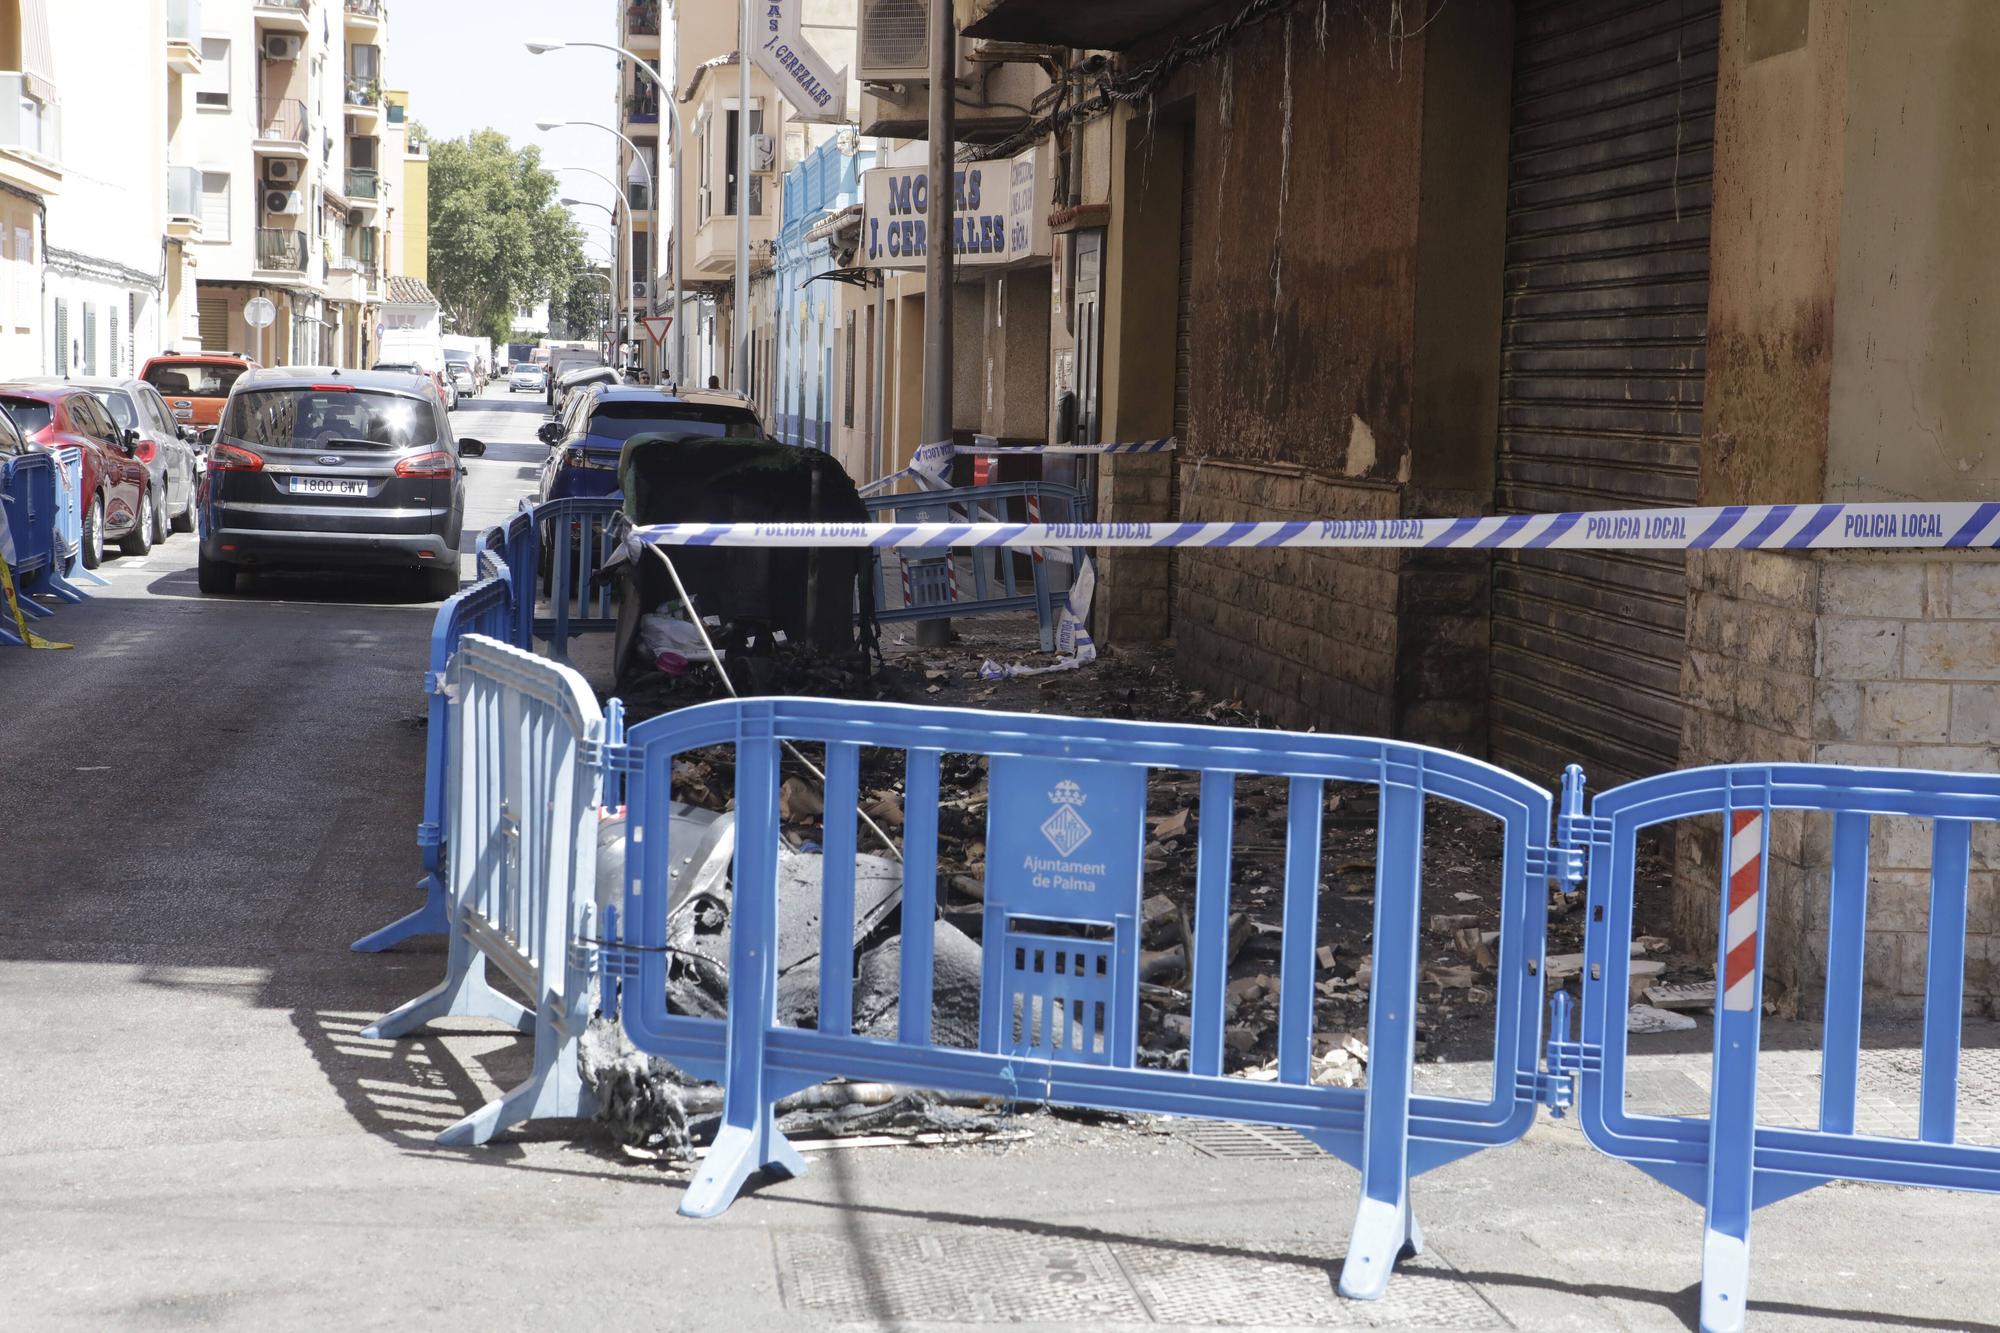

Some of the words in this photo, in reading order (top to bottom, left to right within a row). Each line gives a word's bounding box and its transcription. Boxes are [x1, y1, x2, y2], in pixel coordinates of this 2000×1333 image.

[767, 0, 781, 32] AS
[775, 44, 832, 108] CEREZALES
[889, 169, 982, 216] MOAS
[869, 218, 883, 260] J.
[887, 214, 1005, 258] CERALES
[303, 479, 334, 492] 1800
[340, 480, 365, 493] GWV
[1044, 522, 1102, 540] POLICIA
[1107, 522, 1153, 540] LOCAL
[1320, 519, 1377, 540] POLICIA
[1380, 519, 1425, 540] LOCAL
[1586, 516, 1641, 540] POLICIA
[1643, 516, 1687, 540] LOCAL
[1844, 513, 1897, 538] POLICIA
[1901, 513, 1943, 538] LOCAL
[1023, 855, 1106, 875] Ajuntament
[1032, 873, 1051, 889] de
[1053, 875, 1096, 892] Palma
